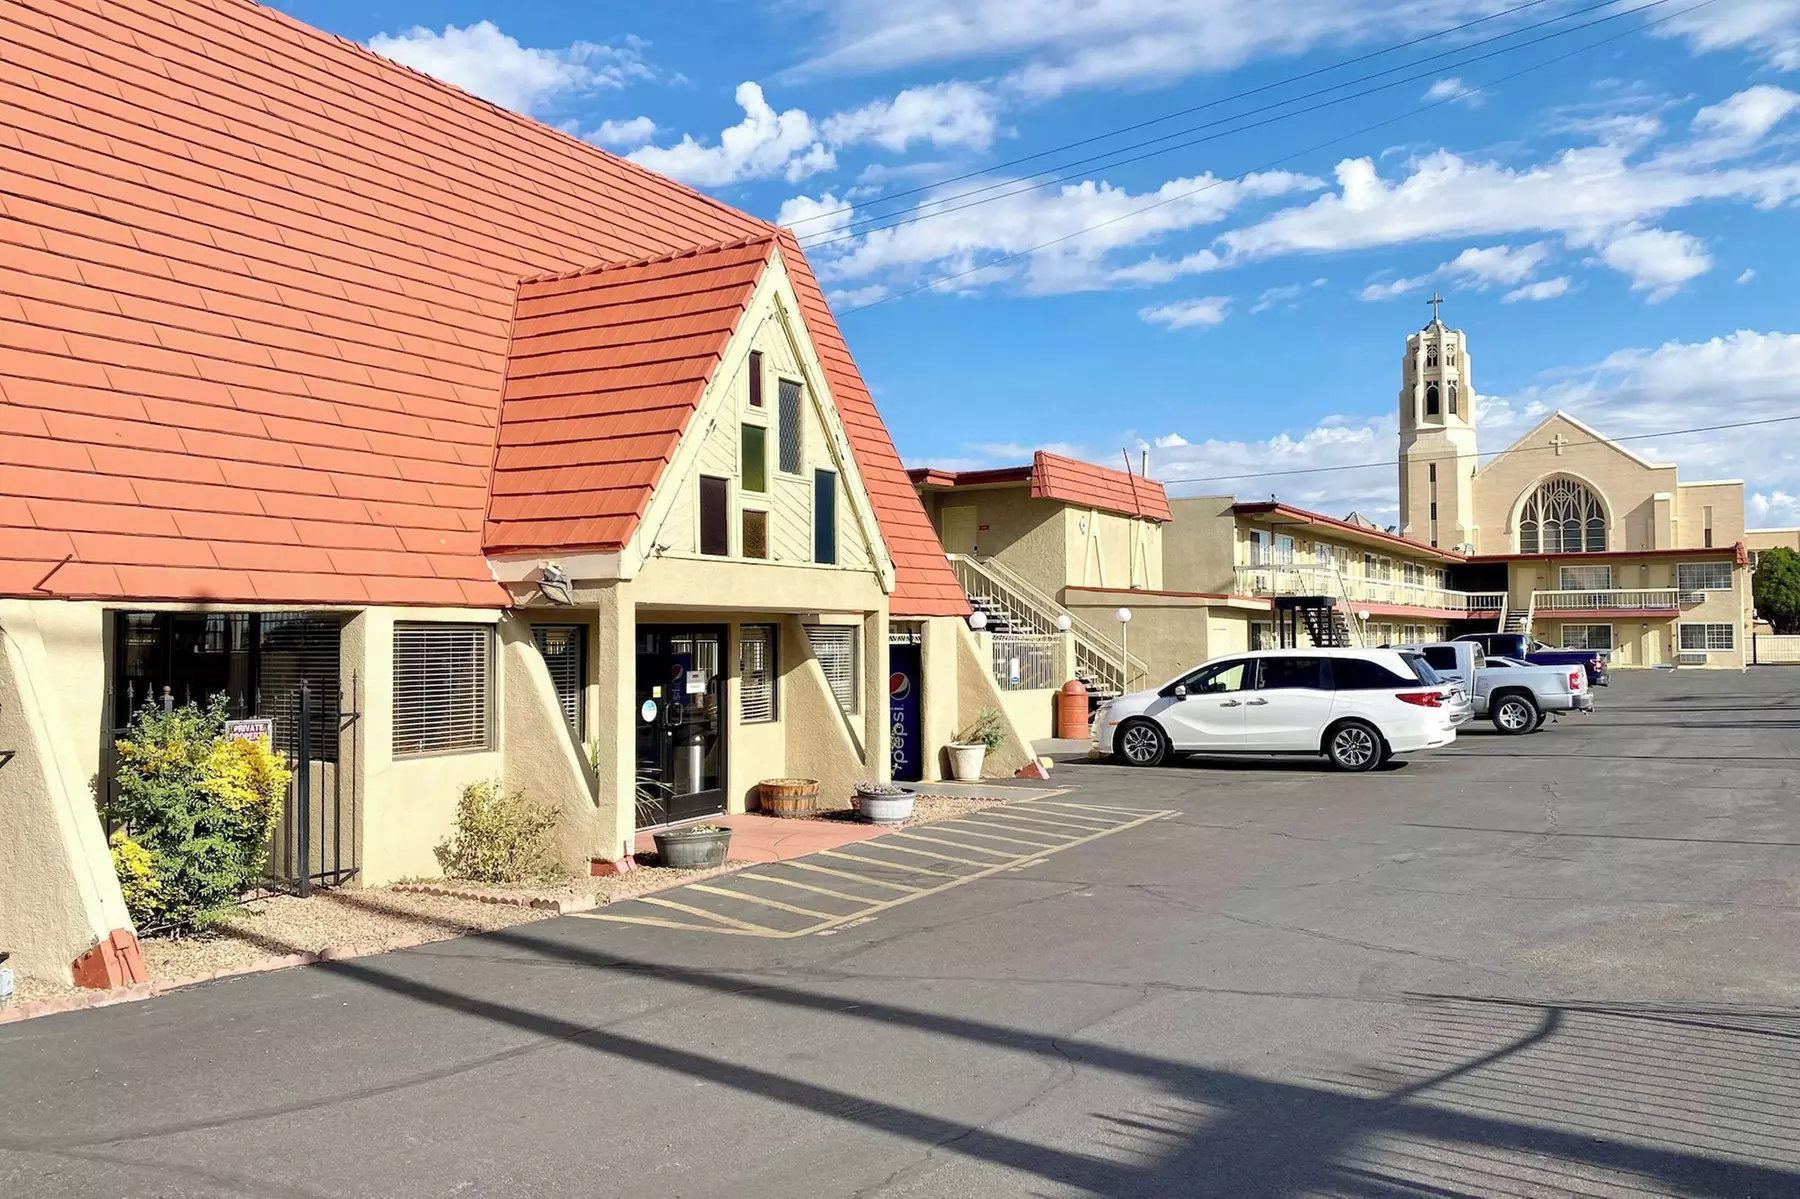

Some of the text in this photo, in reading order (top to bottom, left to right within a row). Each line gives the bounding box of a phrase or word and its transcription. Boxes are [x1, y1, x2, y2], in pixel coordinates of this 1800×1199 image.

[233, 724, 264, 732] PRIVATE
[230, 732, 266, 741] PROPER
[891, 706, 908, 763] pepsi
